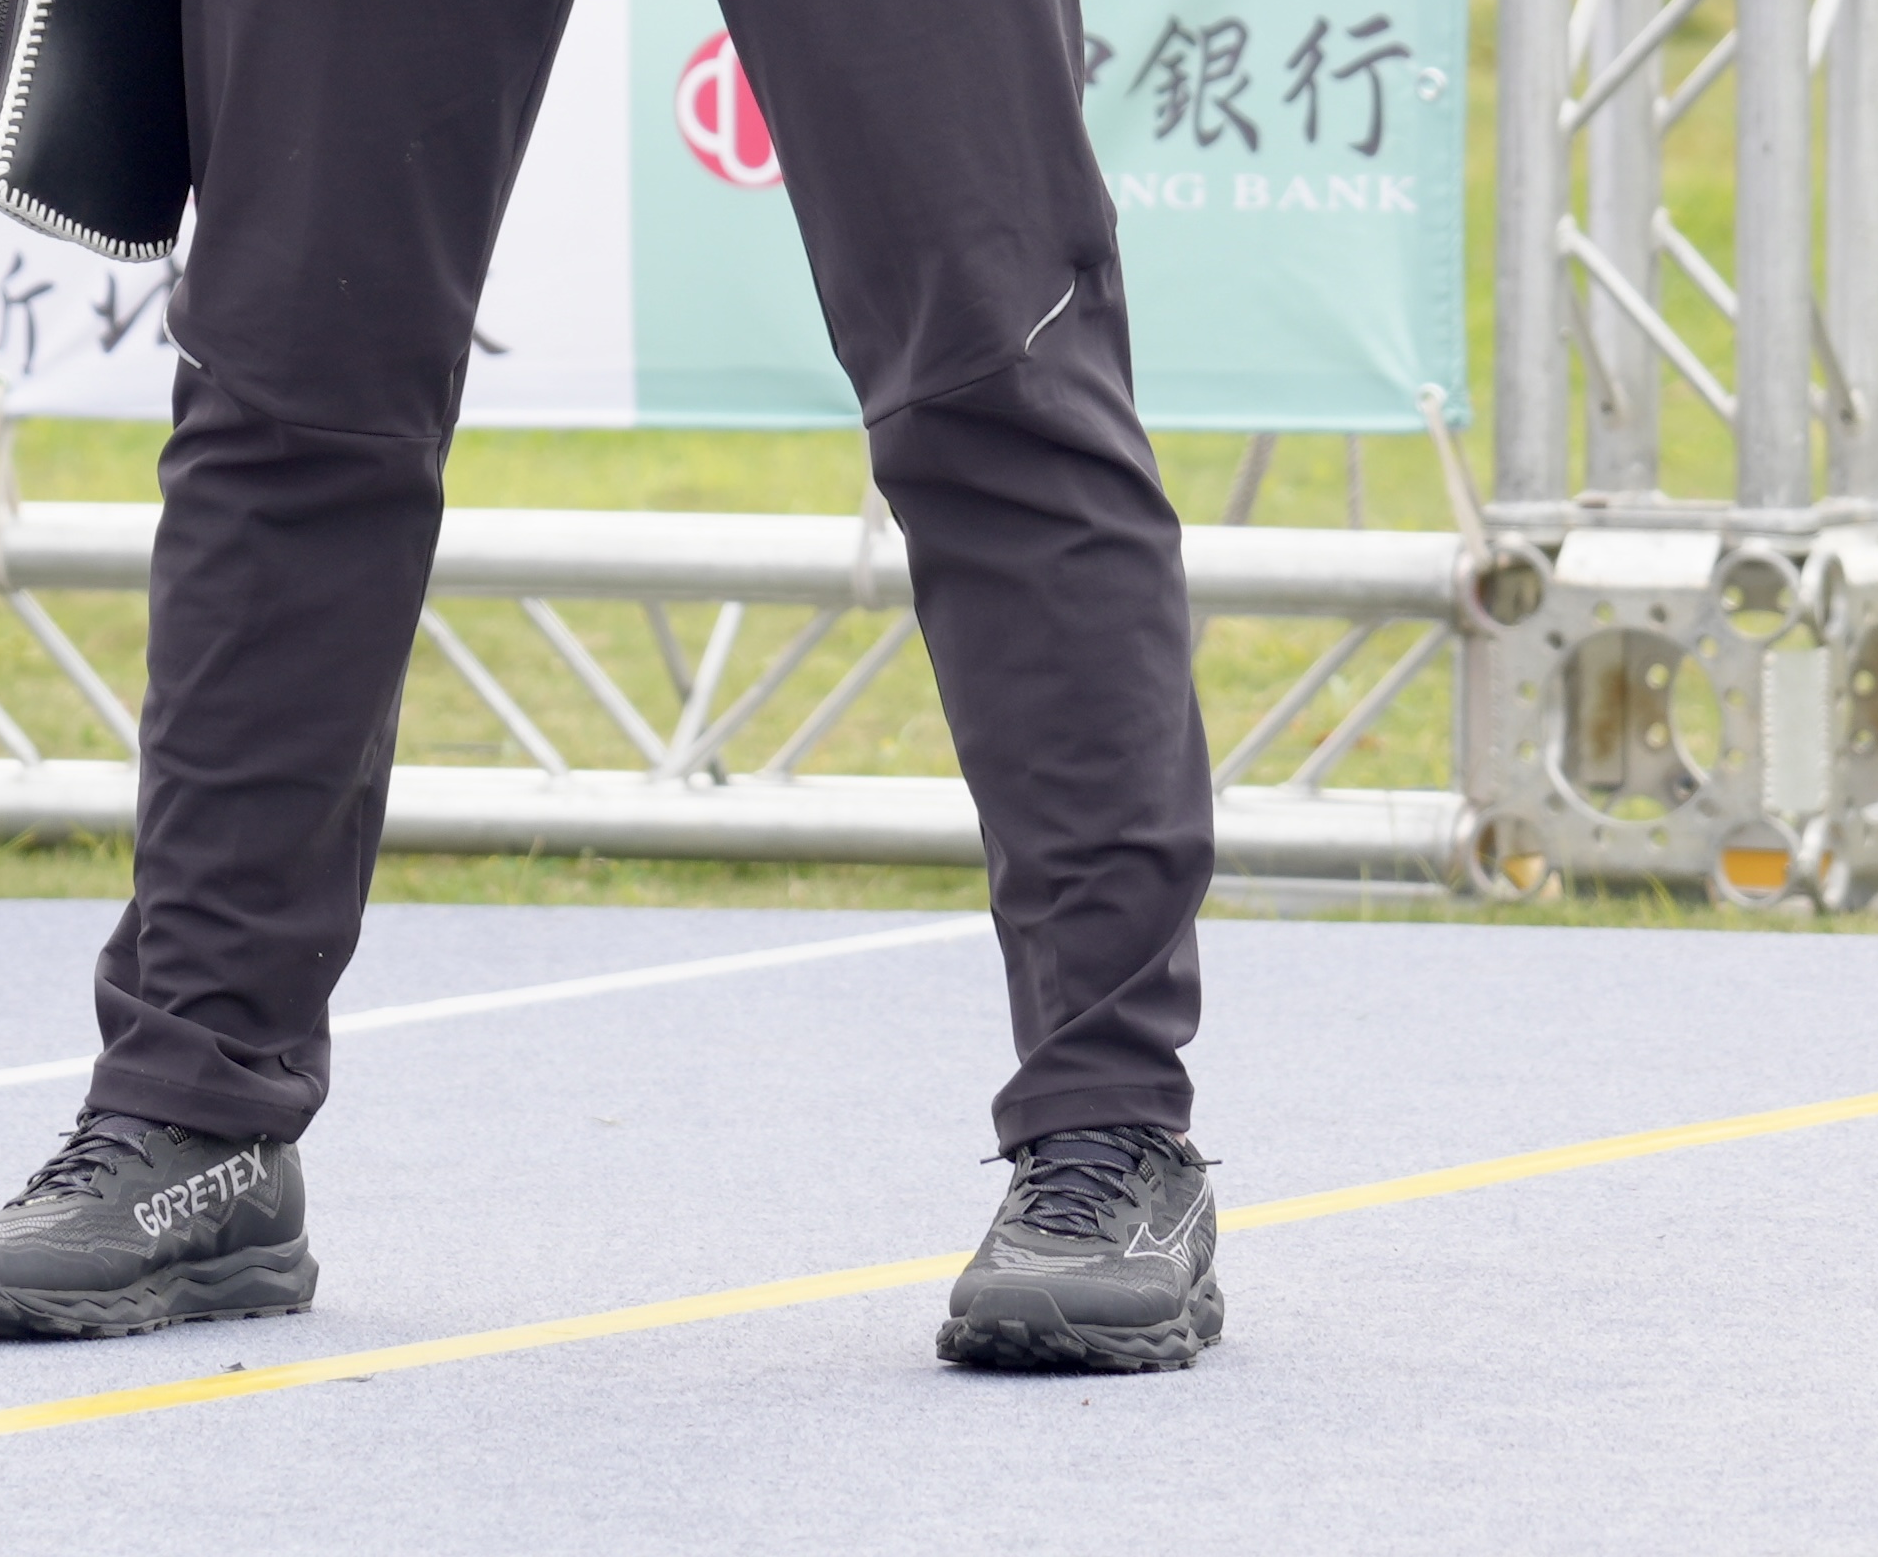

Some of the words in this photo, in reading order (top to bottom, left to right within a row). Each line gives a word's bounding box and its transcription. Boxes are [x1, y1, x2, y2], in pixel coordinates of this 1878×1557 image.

[1083, 11, 1414, 158] 銀行
[1231, 174, 1418, 213] BANK
[133, 1142, 268, 1237] GORE-TEX
